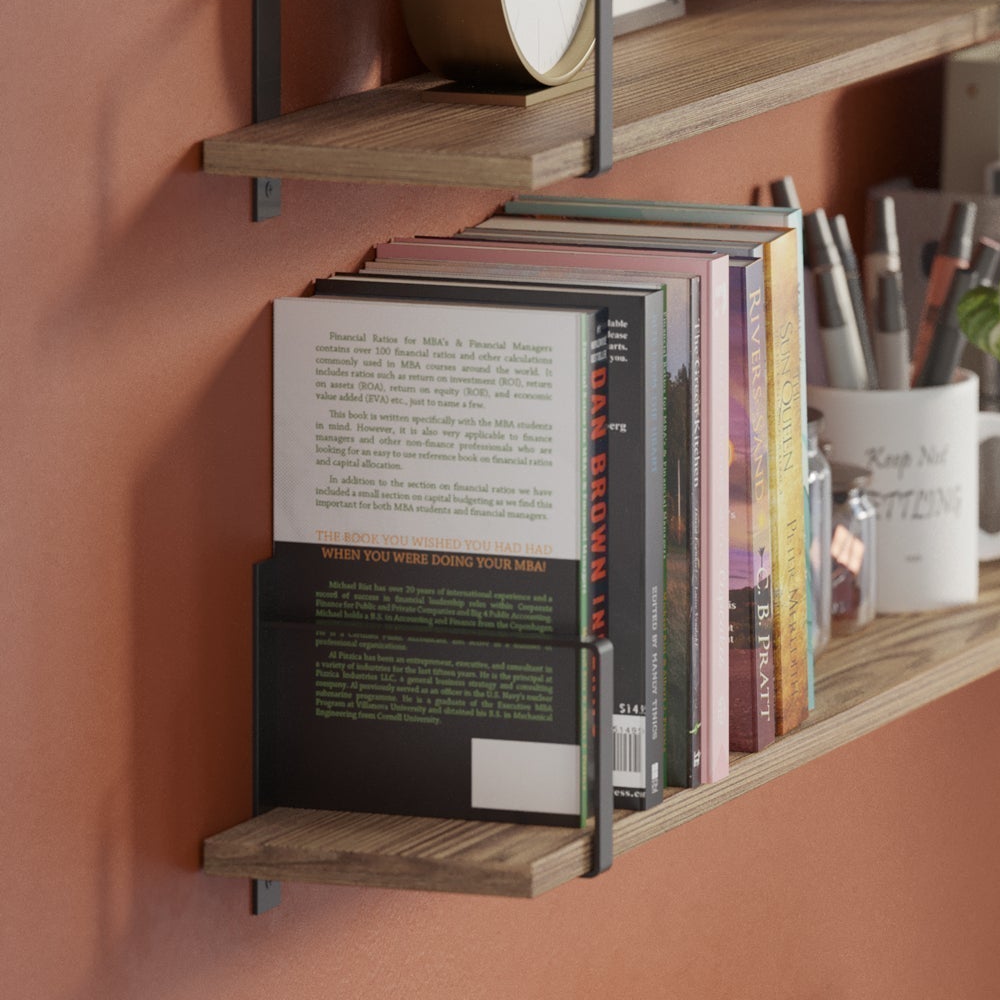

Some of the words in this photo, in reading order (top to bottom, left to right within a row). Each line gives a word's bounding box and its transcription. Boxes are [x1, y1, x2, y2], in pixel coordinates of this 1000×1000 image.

[315, 344, 350, 353] contains
[376, 347, 391, 355] 100
[394, 348, 429, 357] financial
[432, 350, 456, 359] ratios
[459, 351, 475, 360] and
[478, 352, 501, 361] other
[503, 354, 552, 364] calculations
[329, 333, 366, 342] Financial
[372, 335, 398, 344] Ratios
[403, 336, 416, 344] for
[468, 340, 506, 349] Financial
[512, 342, 552, 353] Managers
[778, 320, 793, 376] SUN
[315, 356, 358, 367] commonly
[362, 358, 382, 367] used
[386, 360, 395, 368] in
[400, 360, 420, 369] MBA
[425, 363, 456, 371] courses
[461, 364, 491, 372] around
[495, 365, 509, 373] the
[514, 366, 541, 375] world.
[545, 368, 552, 376] It
[315, 368, 349, 377] includes
[350, 370, 374, 378] ratios
[376, 371, 395, 379] such
[408, 372, 434, 381] return
[449, 375, 495, 384] investment
[526, 379, 552, 388] return
[329, 380, 354, 389] assets
[389, 383, 416, 392] return
[433, 386, 460, 396] equity
[494, 389, 510, 397] and
[513, 390, 551, 400] economic
[591, 366, 608, 440] DAN
[781, 382, 793, 472] QUEEN
[694, 419, 702, 488] Kitchen
[864, 446, 912, 481] Keep
[590, 456, 608, 581] BROWN
[865, 486, 963, 520] ETTLING
[316, 530, 340, 542] THE
[342, 531, 377, 544] BOOK
[383, 534, 408, 546] YOU
[411, 536, 463, 549] WISHED
[464, 539, 490, 551] YOU
[494, 540, 522, 553] HAD
[525, 542, 552, 555] HAD
[322, 547, 360, 560] WHEN
[364, 550, 390, 562] YOU
[393, 551, 428, 564] WERE
[431, 554, 474, 567] DOING
[477, 557, 511, 570] YOUR
[513, 559, 546, 572] MBA!
[786, 519, 798, 583] PETER
[758, 603, 770, 626] B.
[758, 634, 771, 722] PRATT
